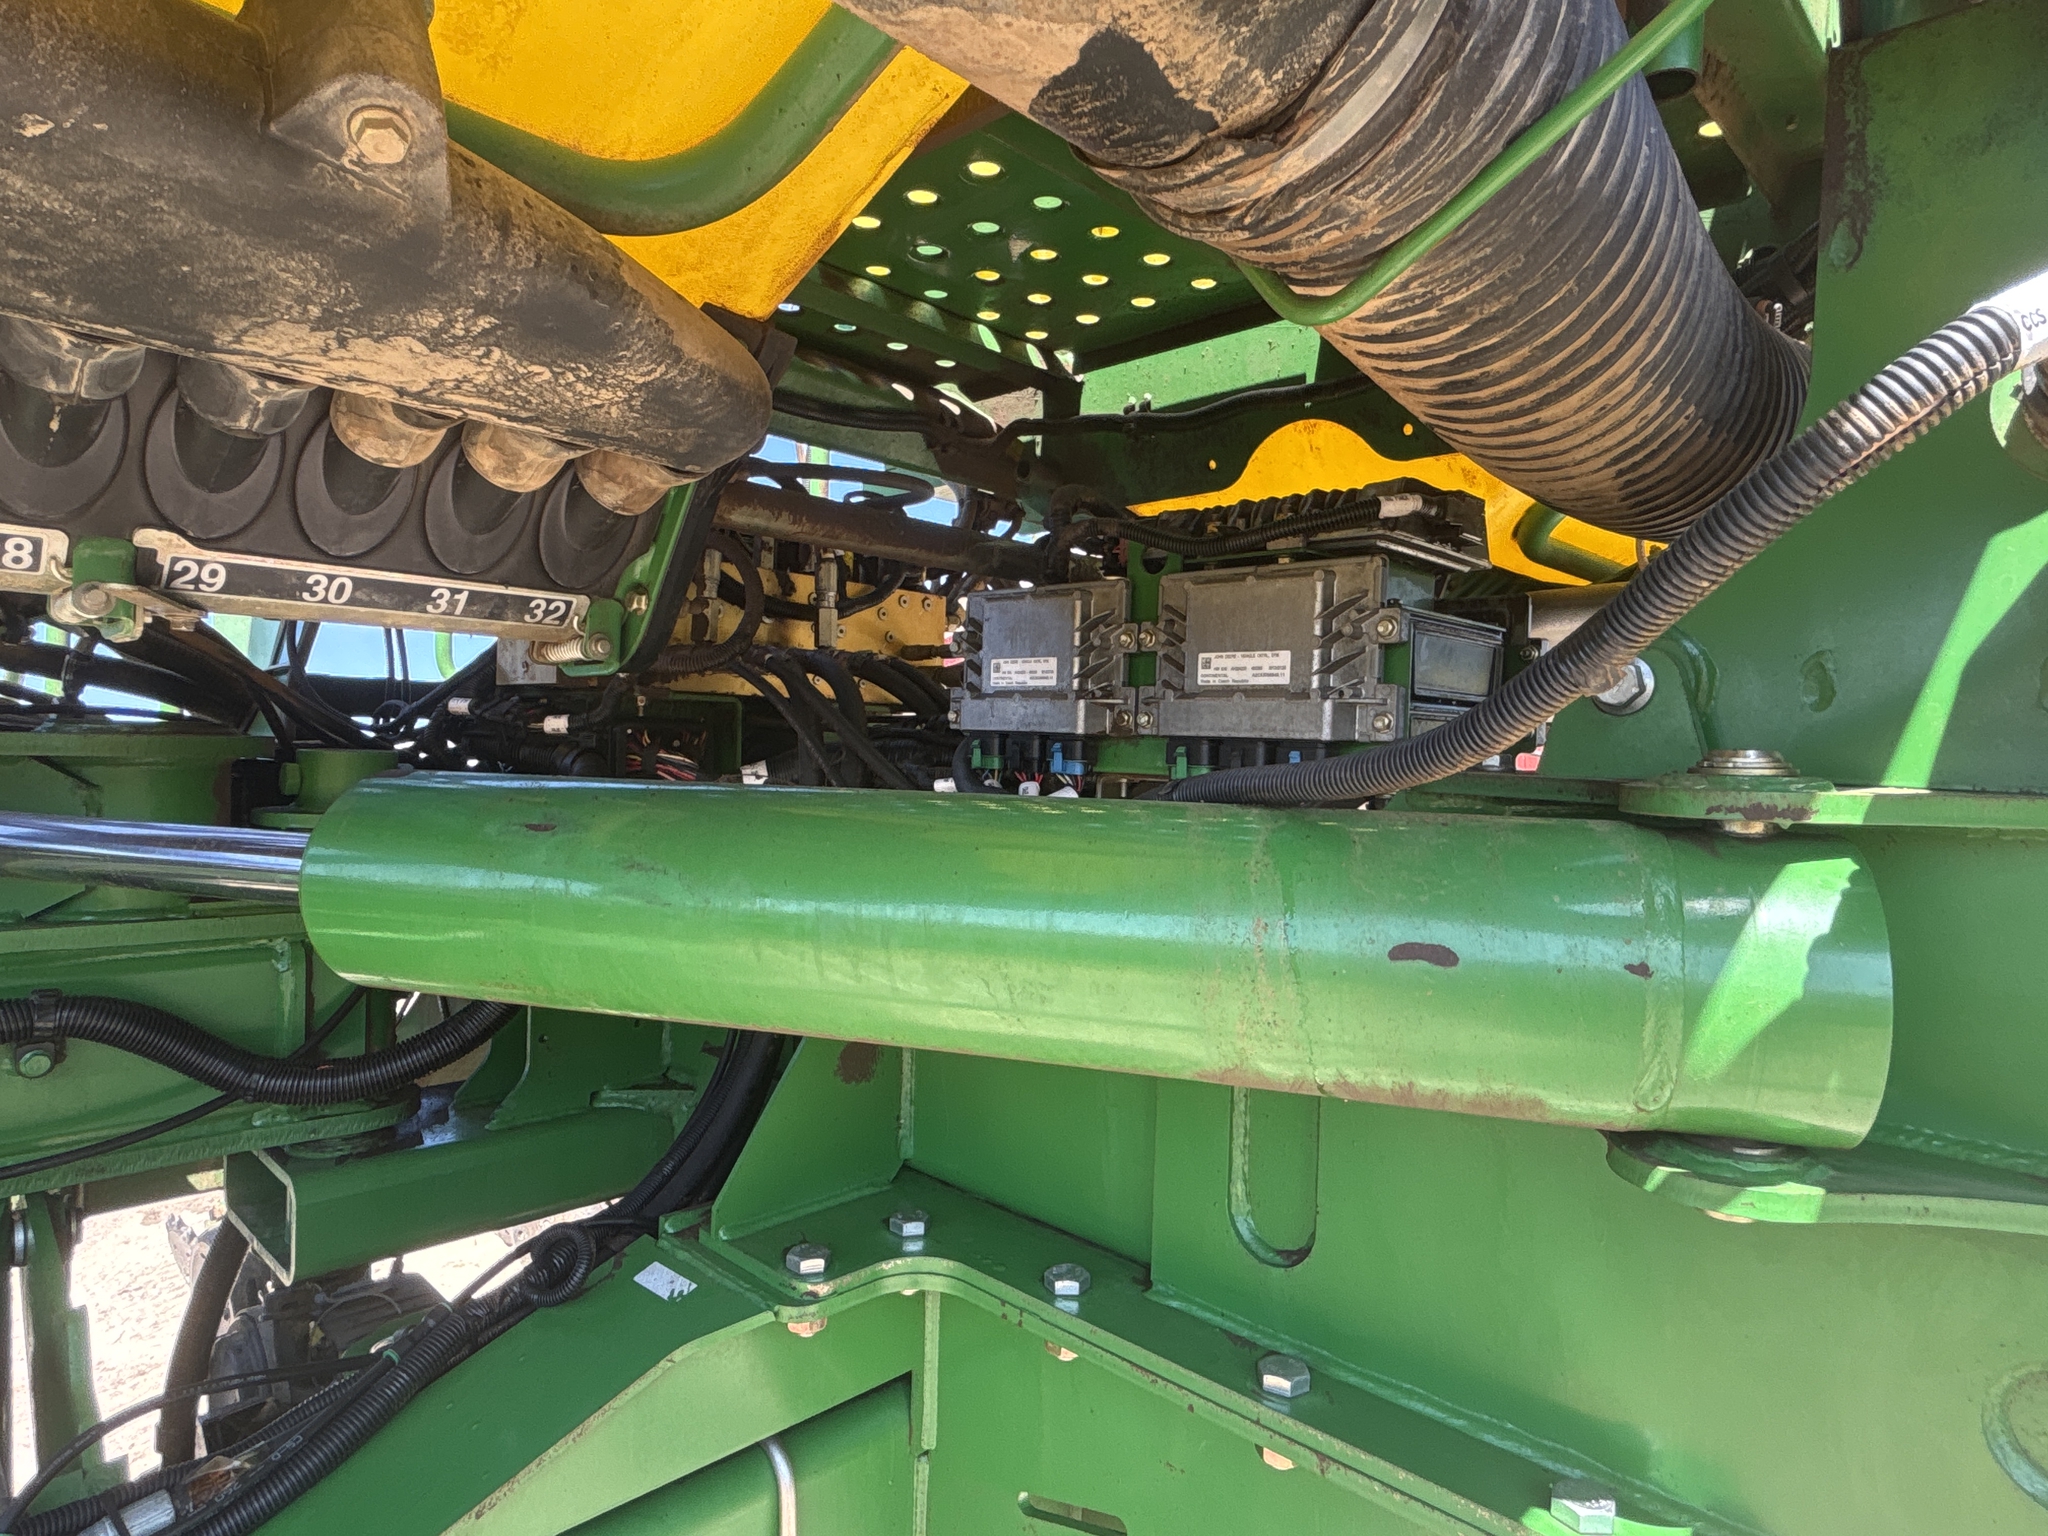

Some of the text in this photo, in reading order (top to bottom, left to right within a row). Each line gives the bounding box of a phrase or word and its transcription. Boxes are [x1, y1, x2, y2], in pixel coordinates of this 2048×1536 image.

[171, 559, 568, 626] 29 30 31 32
